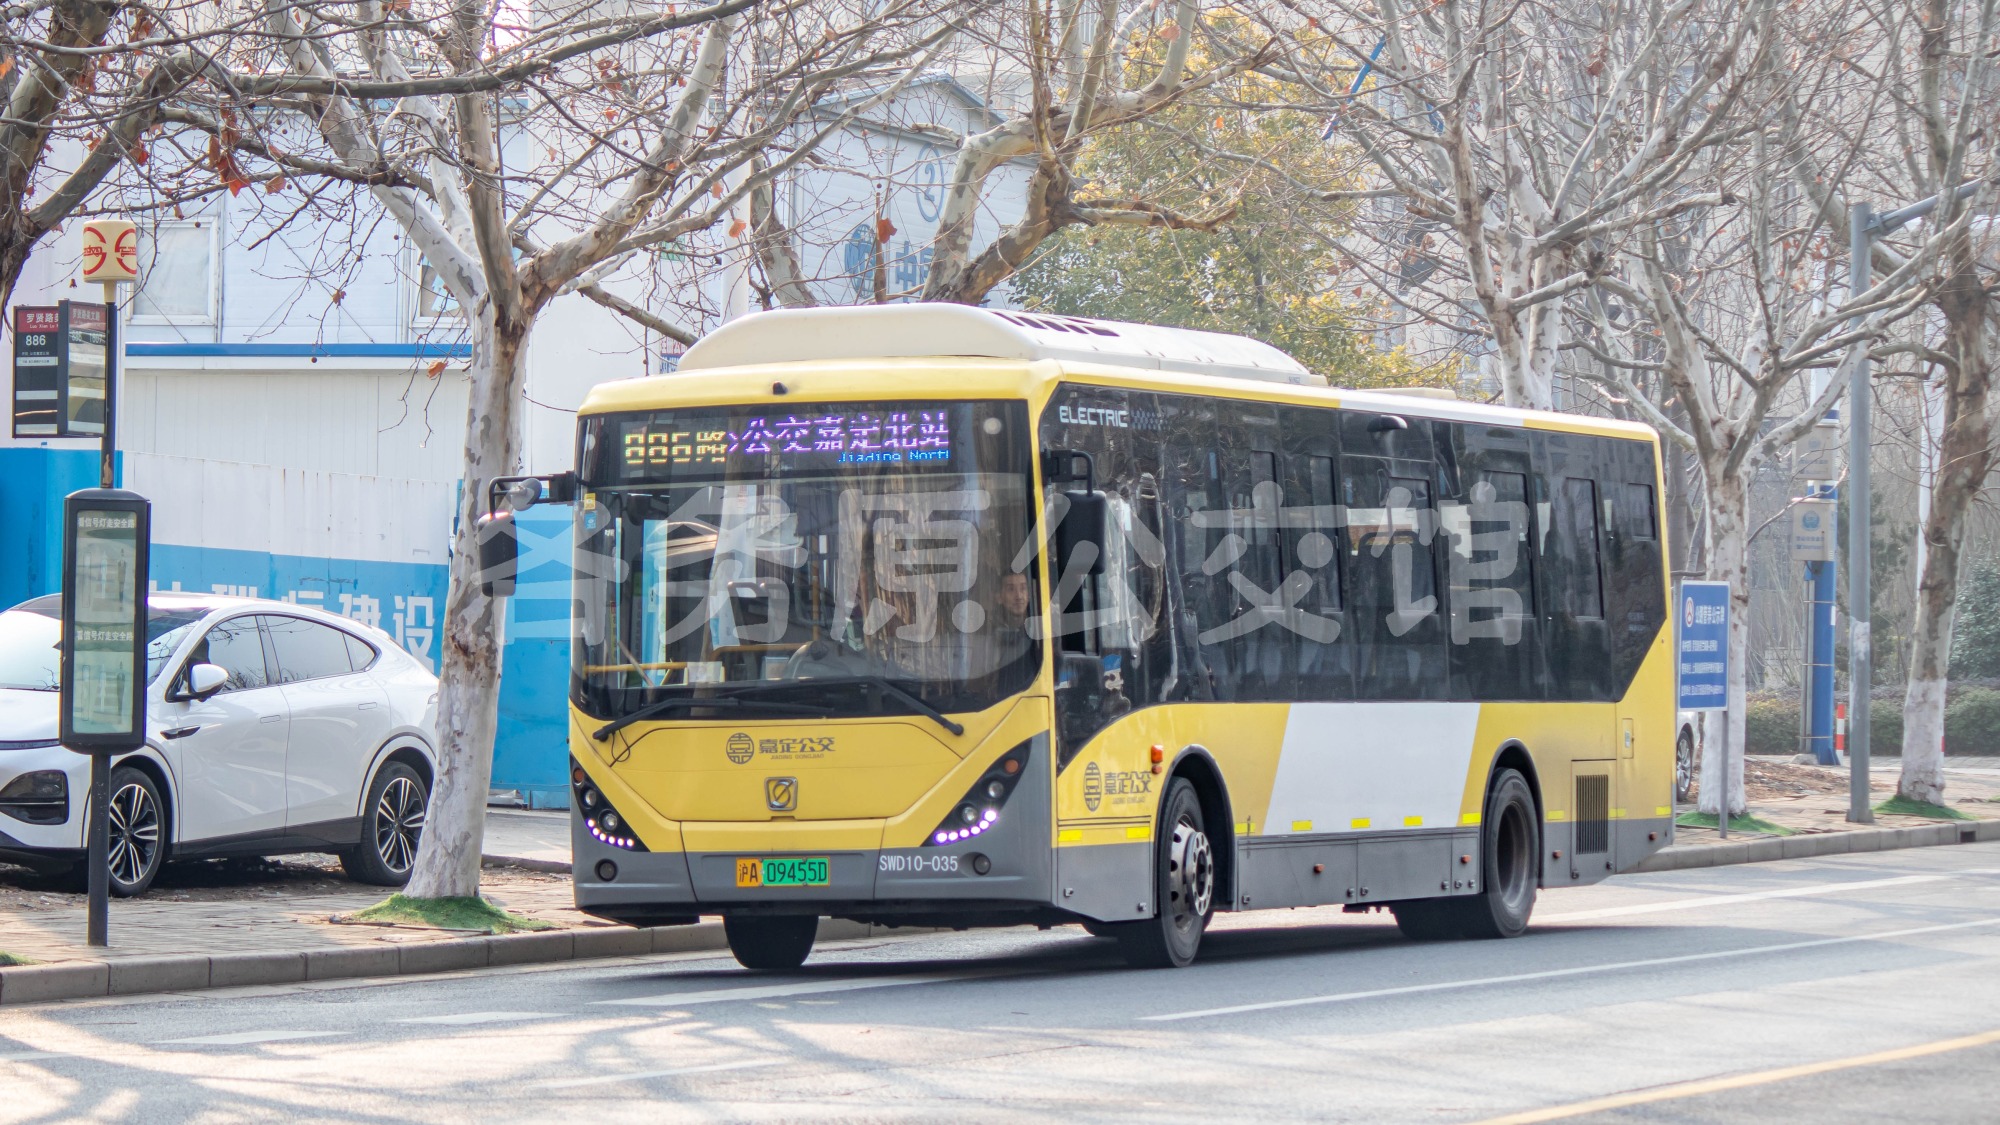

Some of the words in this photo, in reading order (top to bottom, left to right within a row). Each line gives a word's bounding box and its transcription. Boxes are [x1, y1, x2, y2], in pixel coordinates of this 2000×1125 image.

[25, 334, 47, 346] 886
[1059, 405, 1128, 428] ELECTRIC
[759, 736, 836, 754] 嘉定公交
[1104, 770, 1152, 795] 嘉定公交
[766, 862, 828, 883] 09455D
[879, 855, 958, 872] SWD10-035
